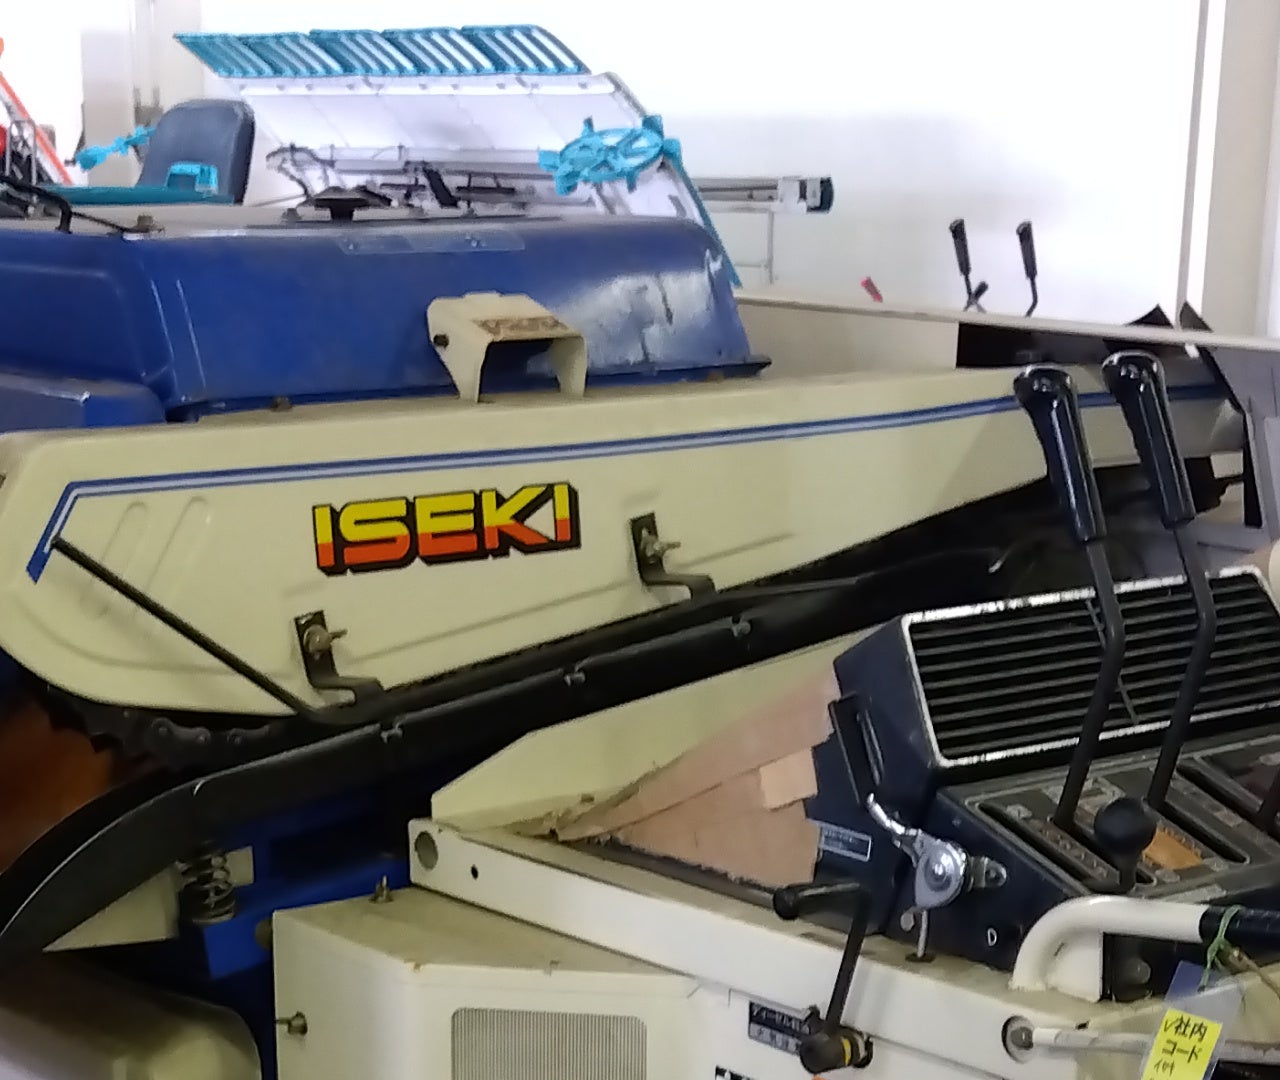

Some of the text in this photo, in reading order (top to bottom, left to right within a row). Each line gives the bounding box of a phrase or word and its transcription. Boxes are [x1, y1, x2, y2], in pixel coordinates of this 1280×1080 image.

[312, 480, 581, 577] ISEKI
[1174, 1014, 1208, 1042] 社内
[1162, 1038, 1201, 1063] コード
